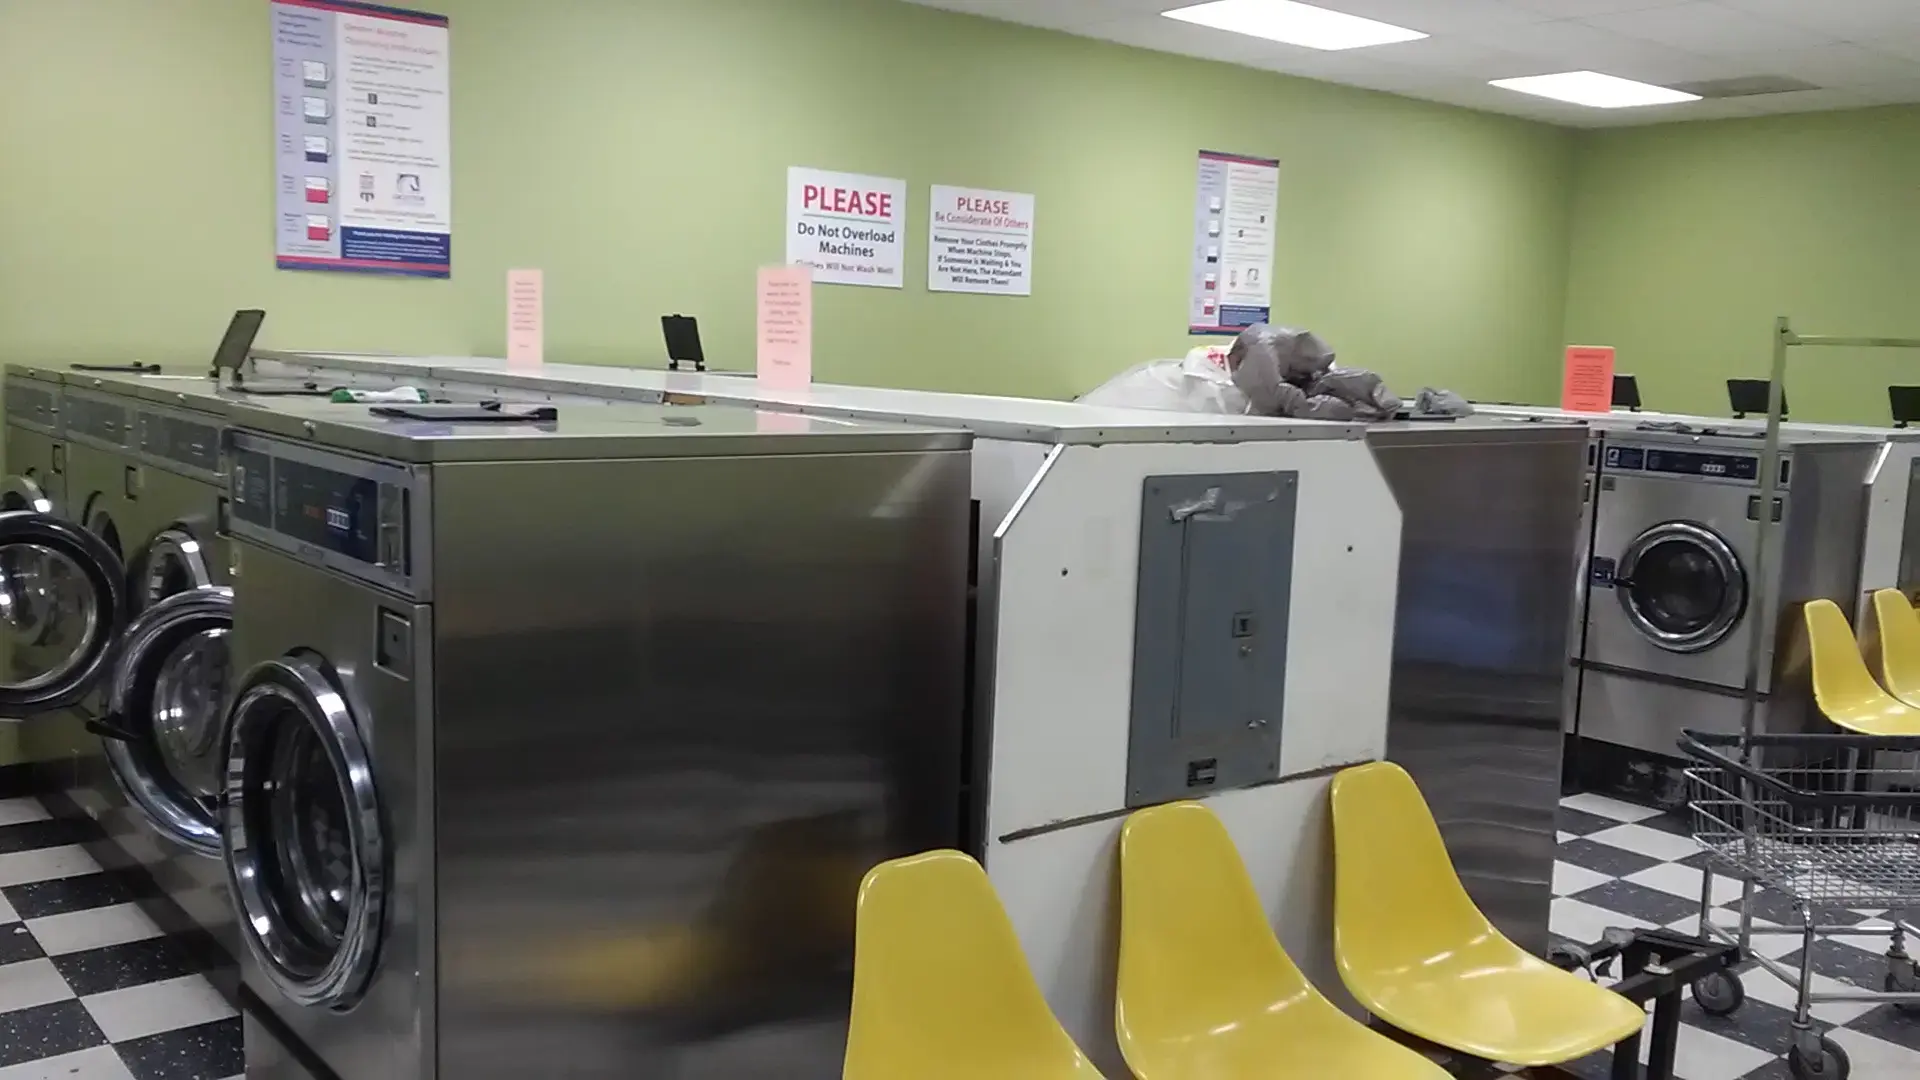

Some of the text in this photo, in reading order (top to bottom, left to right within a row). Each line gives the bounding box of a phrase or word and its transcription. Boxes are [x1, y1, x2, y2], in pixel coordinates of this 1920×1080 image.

[803, 184, 892, 218] PLEASE
[957, 196, 1010, 215] PLEASE
[935, 211, 945, 222] Be
[946, 212, 992, 227] Considerate
[1004, 217, 1029, 230] Others
[797, 222, 895, 244] Do Not Overload
[819, 241, 875, 258] Machines
